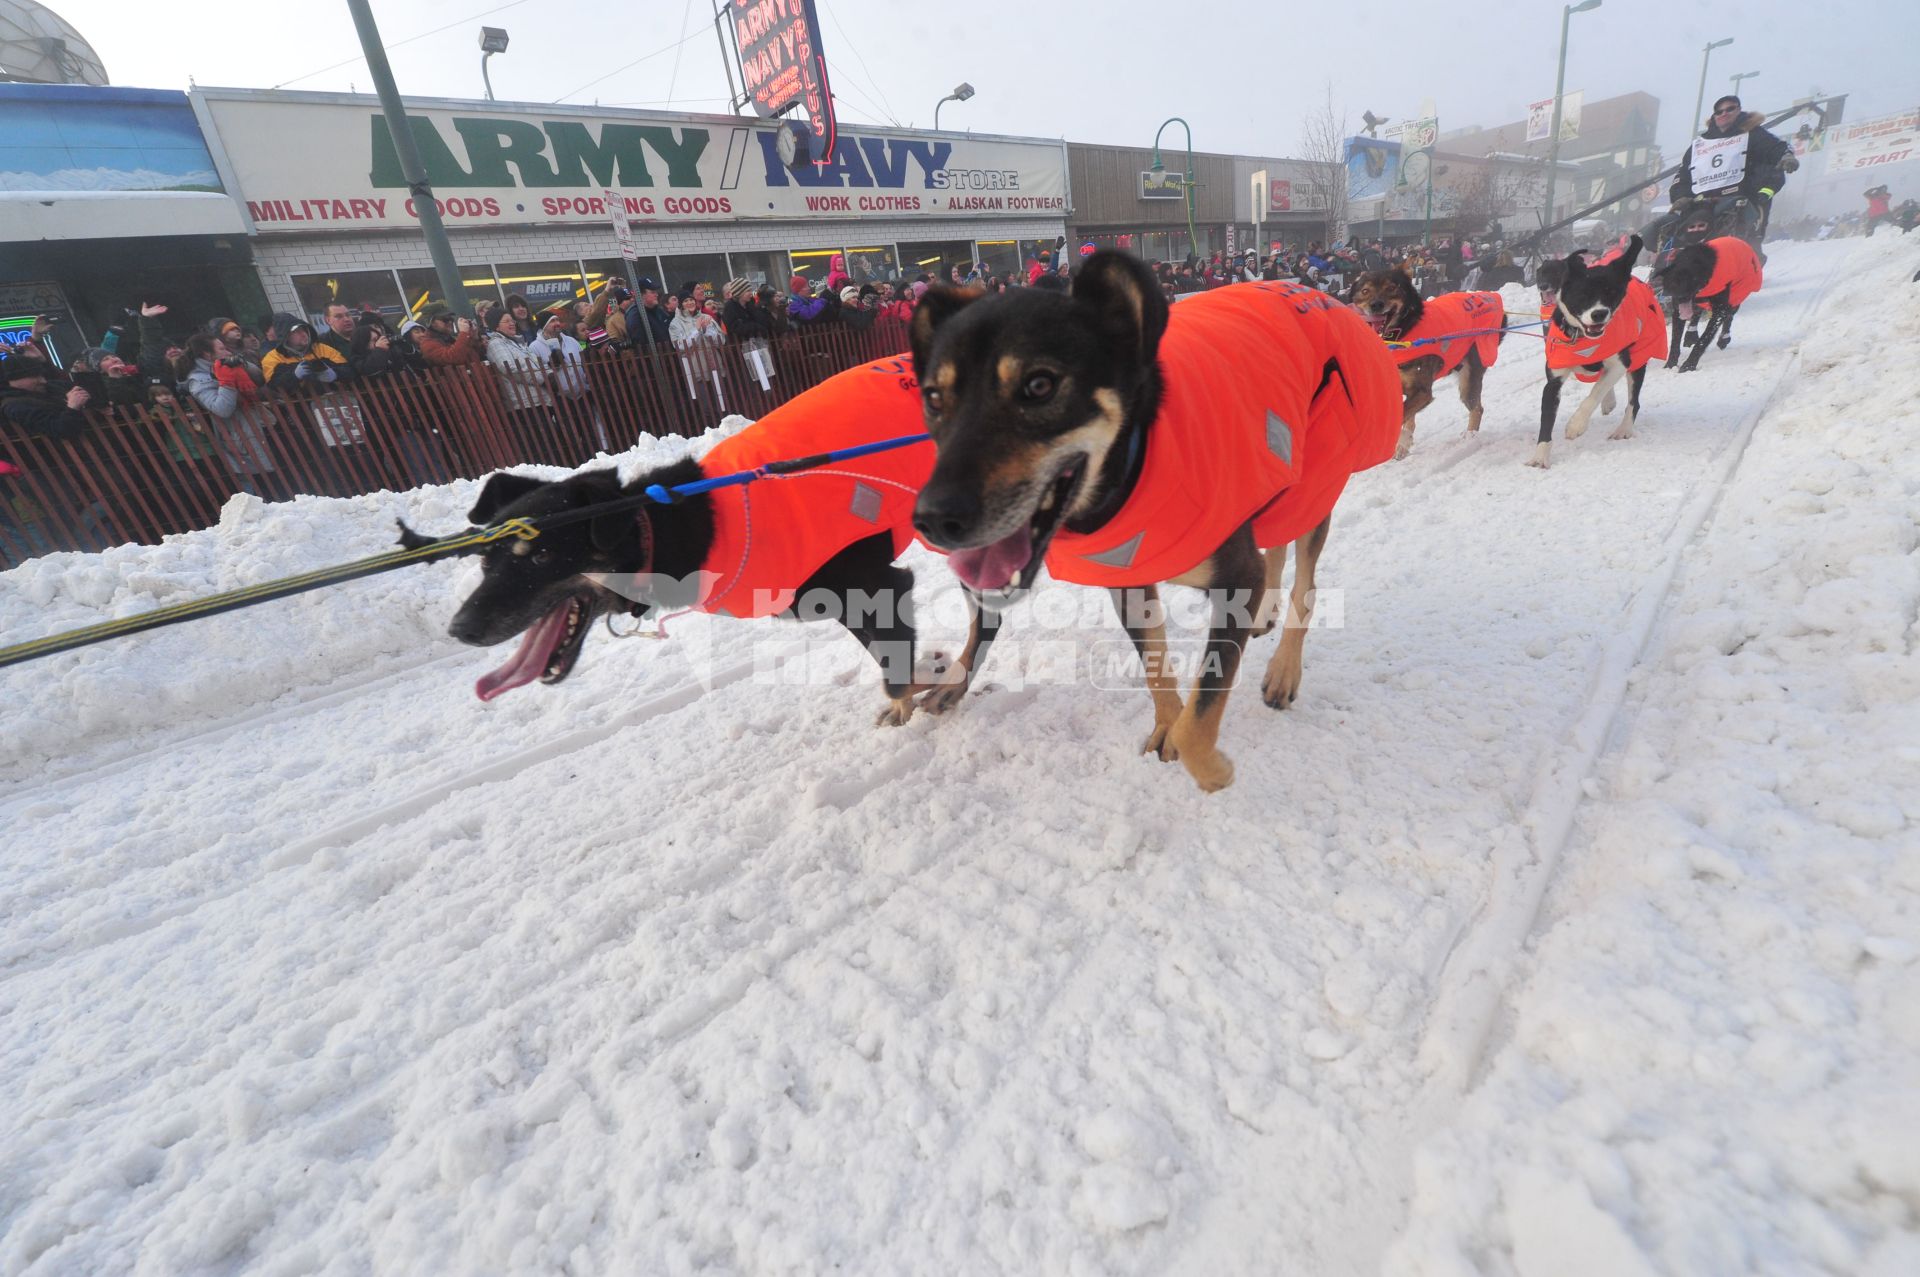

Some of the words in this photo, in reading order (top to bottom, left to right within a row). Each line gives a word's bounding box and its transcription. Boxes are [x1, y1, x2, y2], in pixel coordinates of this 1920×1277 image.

[743, 25, 795, 90] NAVY
[369, 114, 710, 188] ARMY
[757, 131, 952, 189] NAVY
[932, 169, 1020, 190] STORE
[1711, 154, 1723, 168] 6
[1854, 148, 1914, 168] START
[247, 198, 386, 221] MILITARY
[543, 197, 655, 215] SPORNG
[664, 197, 732, 214] GOODS
[806, 196, 851, 211] WORK
[859, 196, 921, 211] CLOTHES
[948, 197, 1002, 210] ALASKAN
[1008, 197, 1064, 210] FOOTWEAR
[526, 281, 571, 294] BAFFIN
